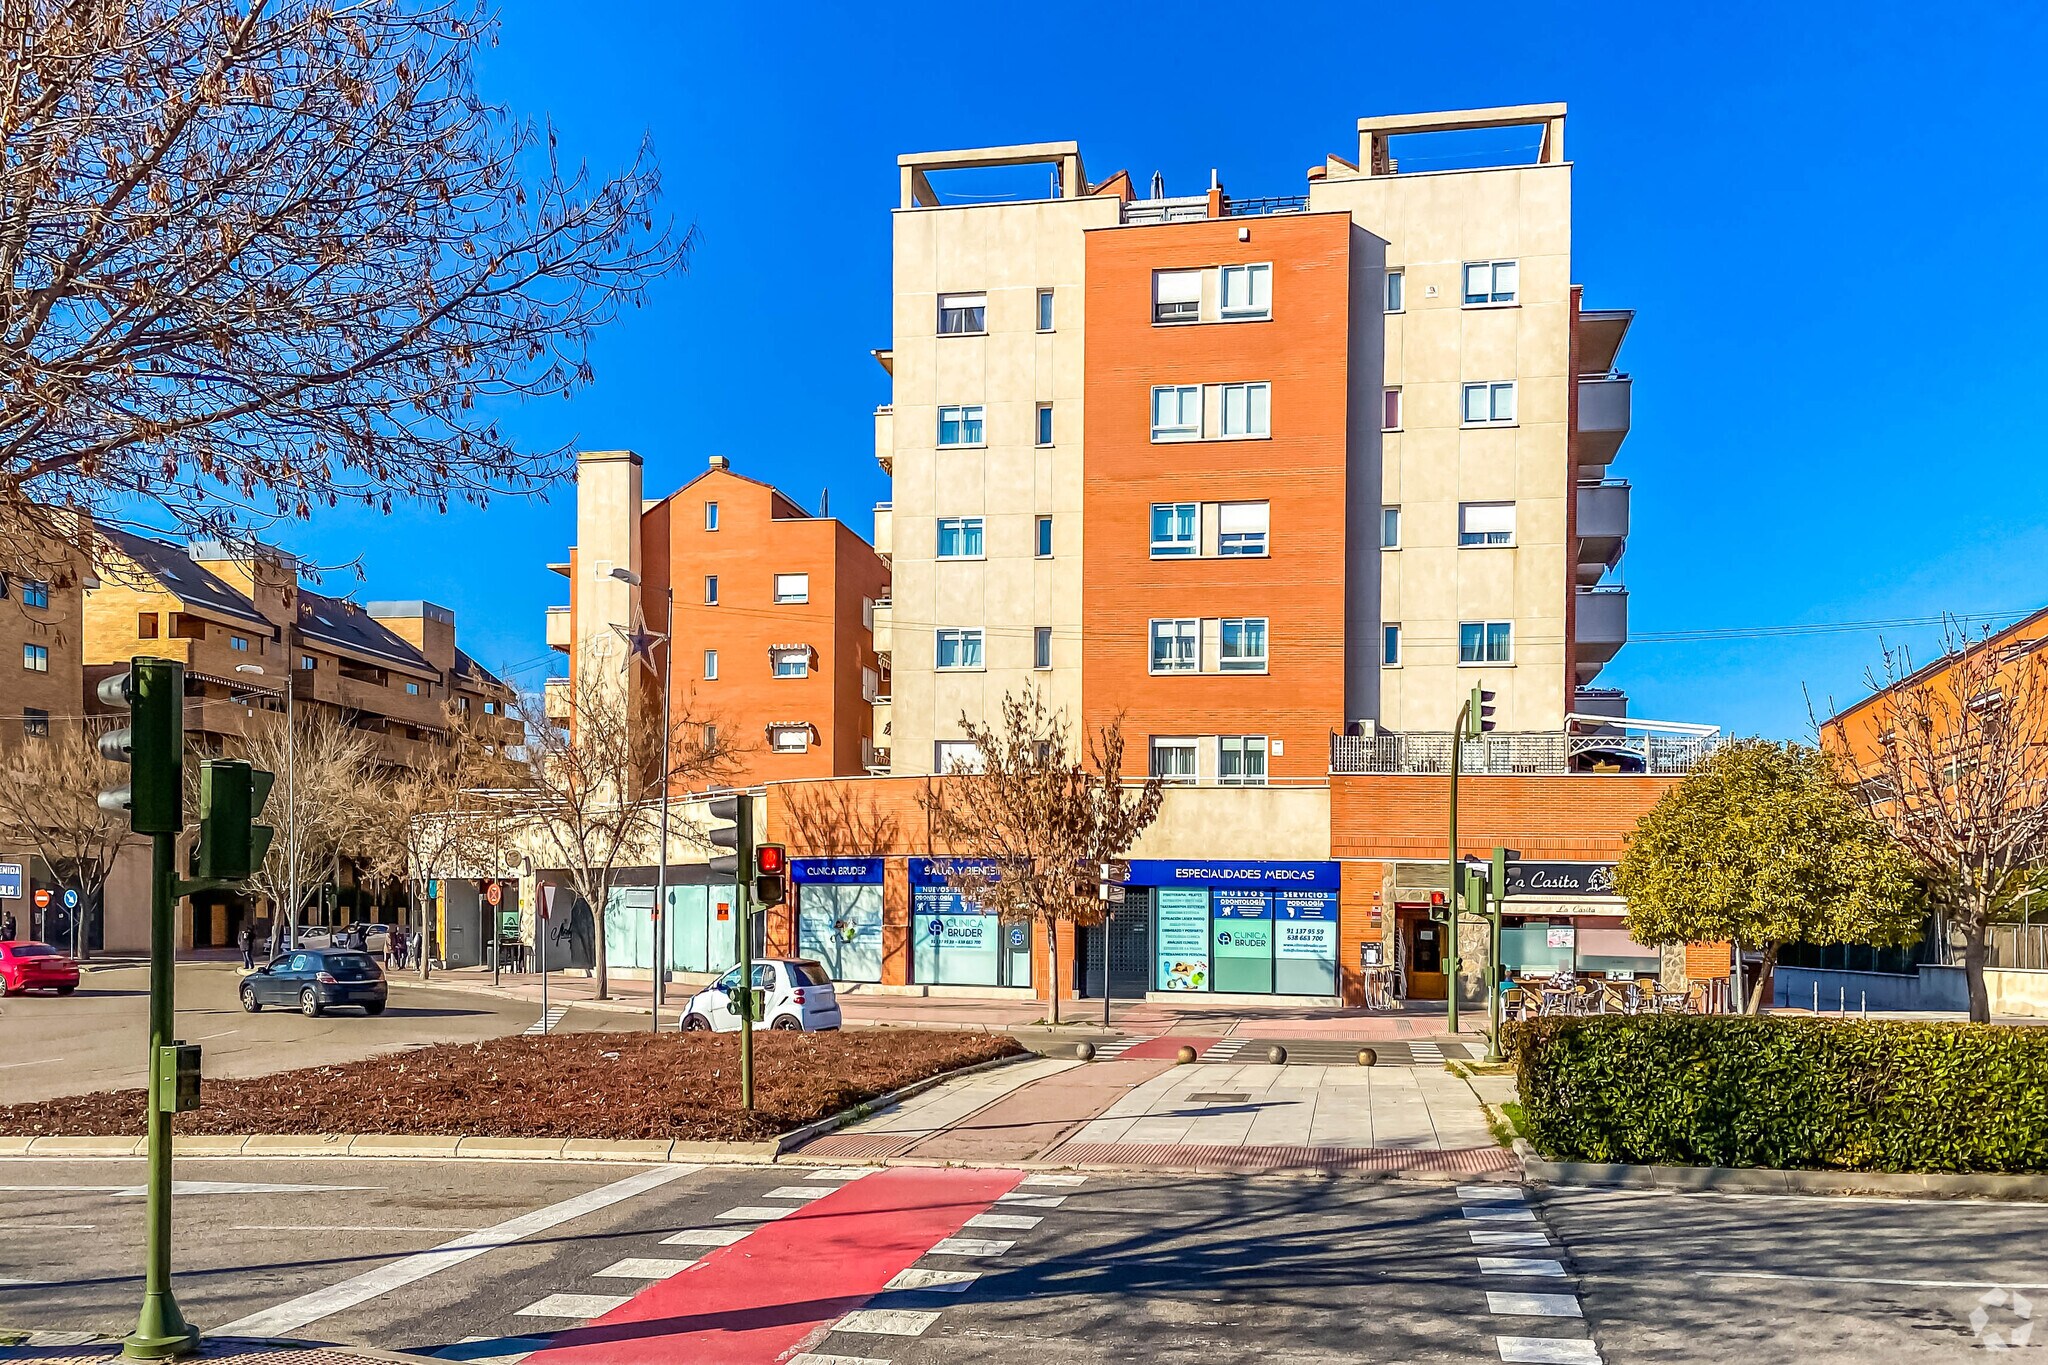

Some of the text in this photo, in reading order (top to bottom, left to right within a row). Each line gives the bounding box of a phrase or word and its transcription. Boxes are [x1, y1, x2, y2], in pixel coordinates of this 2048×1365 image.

[838, 866, 867, 876] BRUDER
[924, 865, 954, 876] SALUD
[957, 866, 964, 876] Y
[1175, 868, 1315, 880] ESPECIALIDADES MEDICAS
[1530, 870, 1580, 889] Casita
[1283, 891, 1329, 899] SERVICIOS
[1220, 897, 1266, 906] ODONTOLOGÍA
[1286, 899, 1325, 908] PODOLOGÍA
[1573, 904, 1596, 914] Casita
[946, 917, 984, 928] CLINICA
[947, 928, 983, 938] BRUDER
[1234, 931, 1267, 940] CLINICA
[1234, 939, 1267, 947] BRUDER
